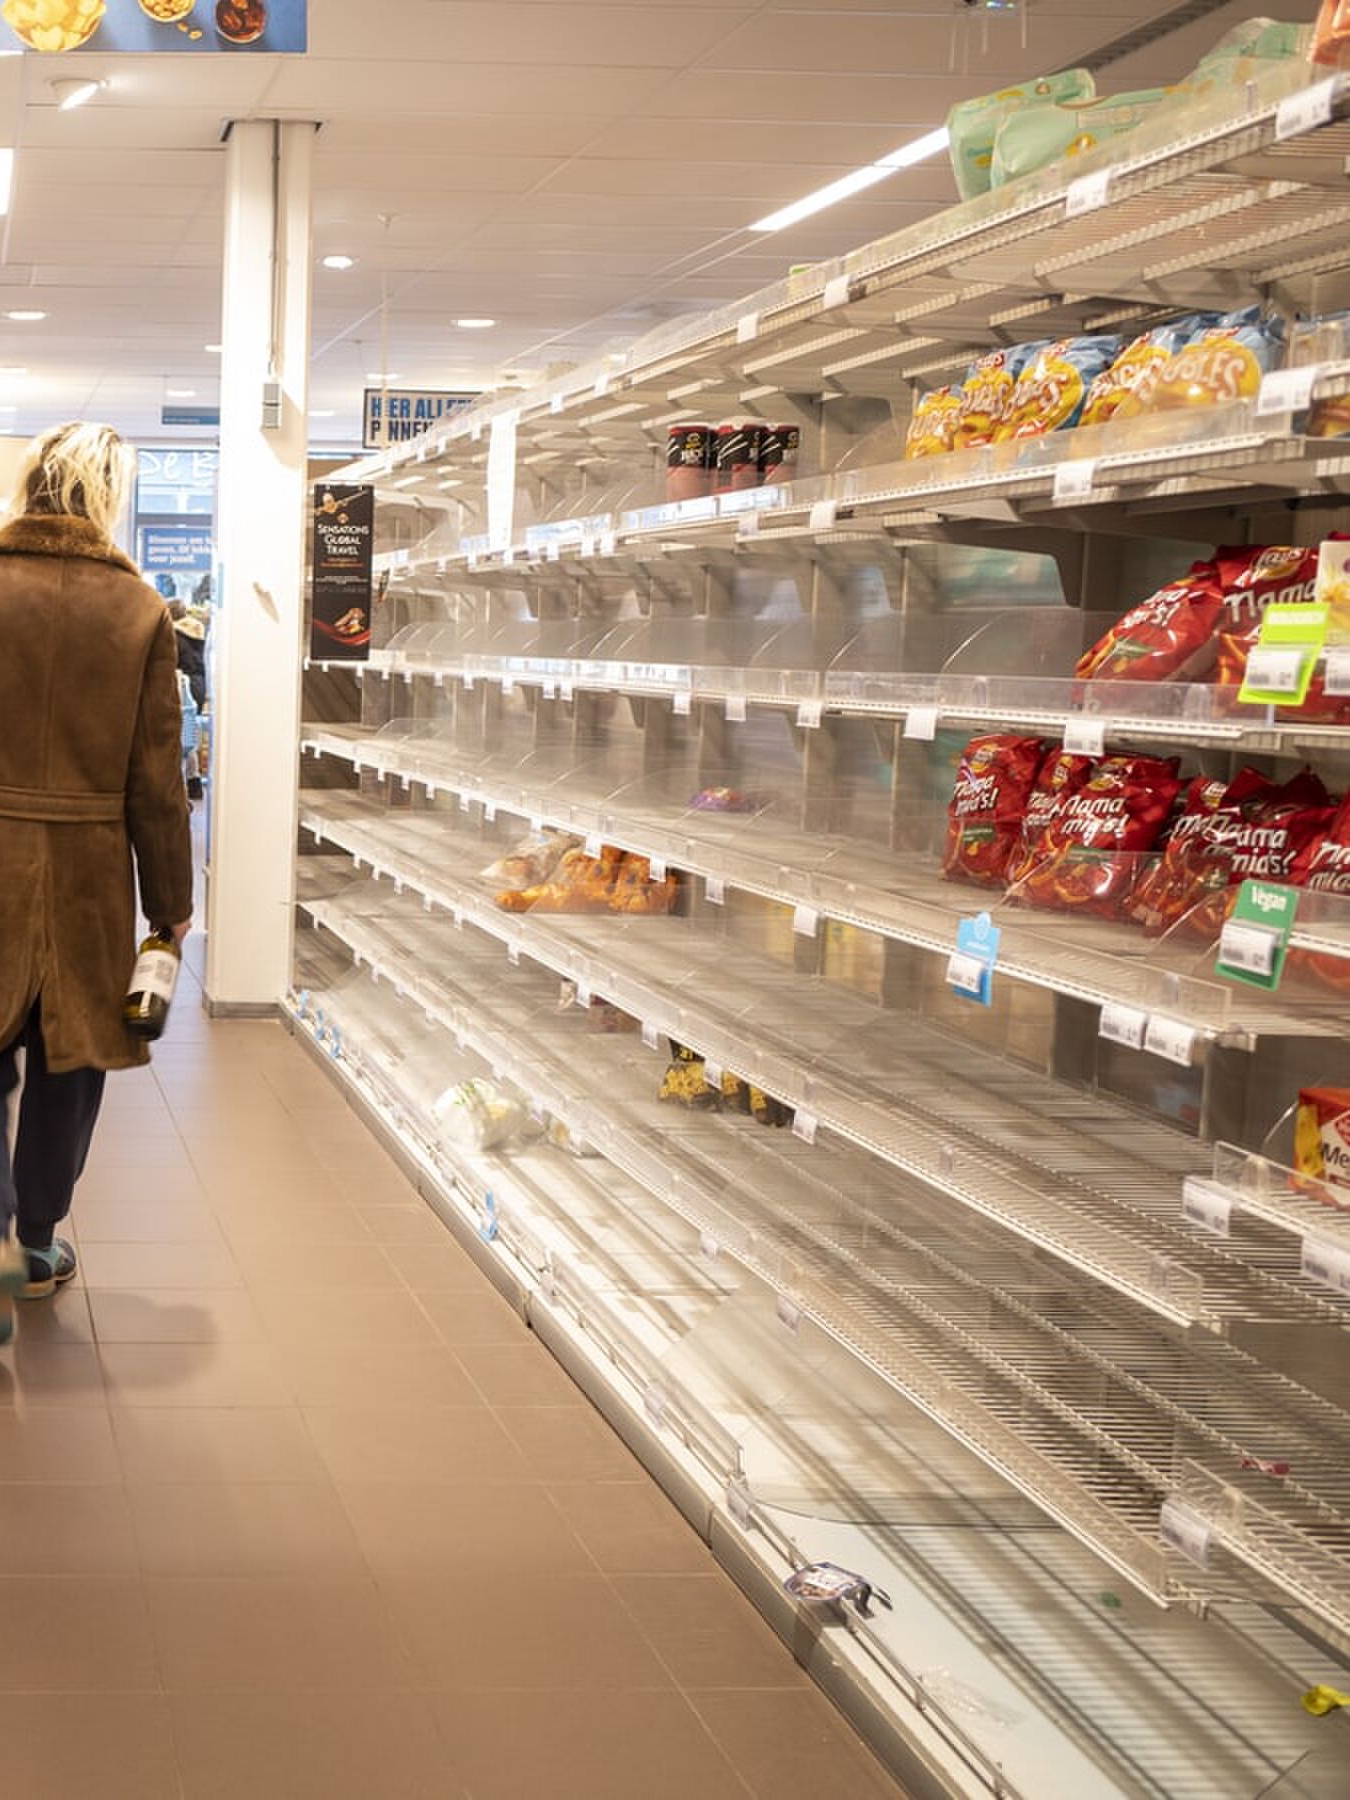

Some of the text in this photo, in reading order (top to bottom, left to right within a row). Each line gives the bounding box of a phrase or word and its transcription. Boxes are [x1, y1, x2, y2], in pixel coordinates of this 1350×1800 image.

[371, 397, 472, 418] HER ALL
[371, 420, 433, 442] PNNE
[317, 524, 370, 535] SENSATIONS
[324, 535, 362, 545] GLOBAL
[326, 545, 360, 555] TRAVEL
[1060, 794, 1127, 818] Mama
[1251, 885, 1288, 913] Vegan
